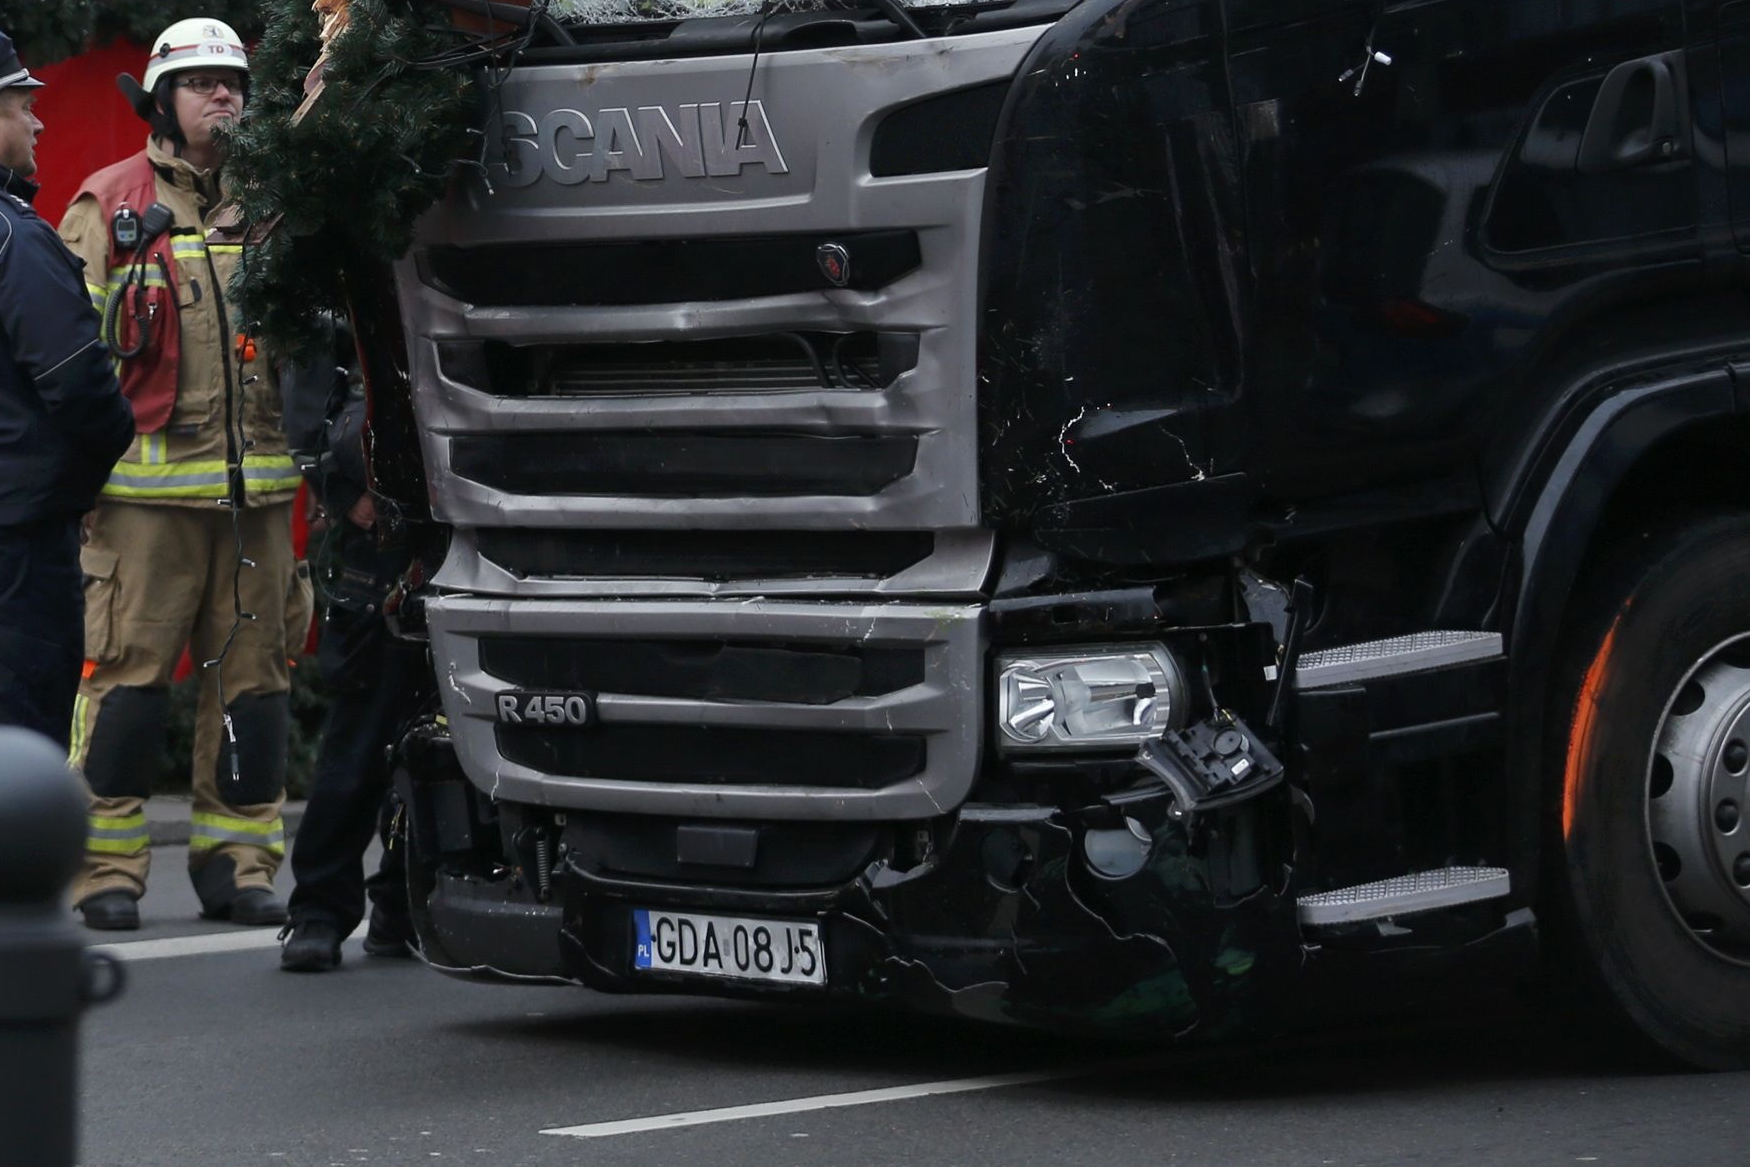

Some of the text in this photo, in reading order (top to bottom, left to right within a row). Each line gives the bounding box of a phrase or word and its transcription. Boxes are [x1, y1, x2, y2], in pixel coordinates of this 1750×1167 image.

[206, 44, 225, 55] TD
[495, 98, 790, 188] SCANIA
[637, 944, 650, 958] PL
[655, 916, 724, 970] GDA
